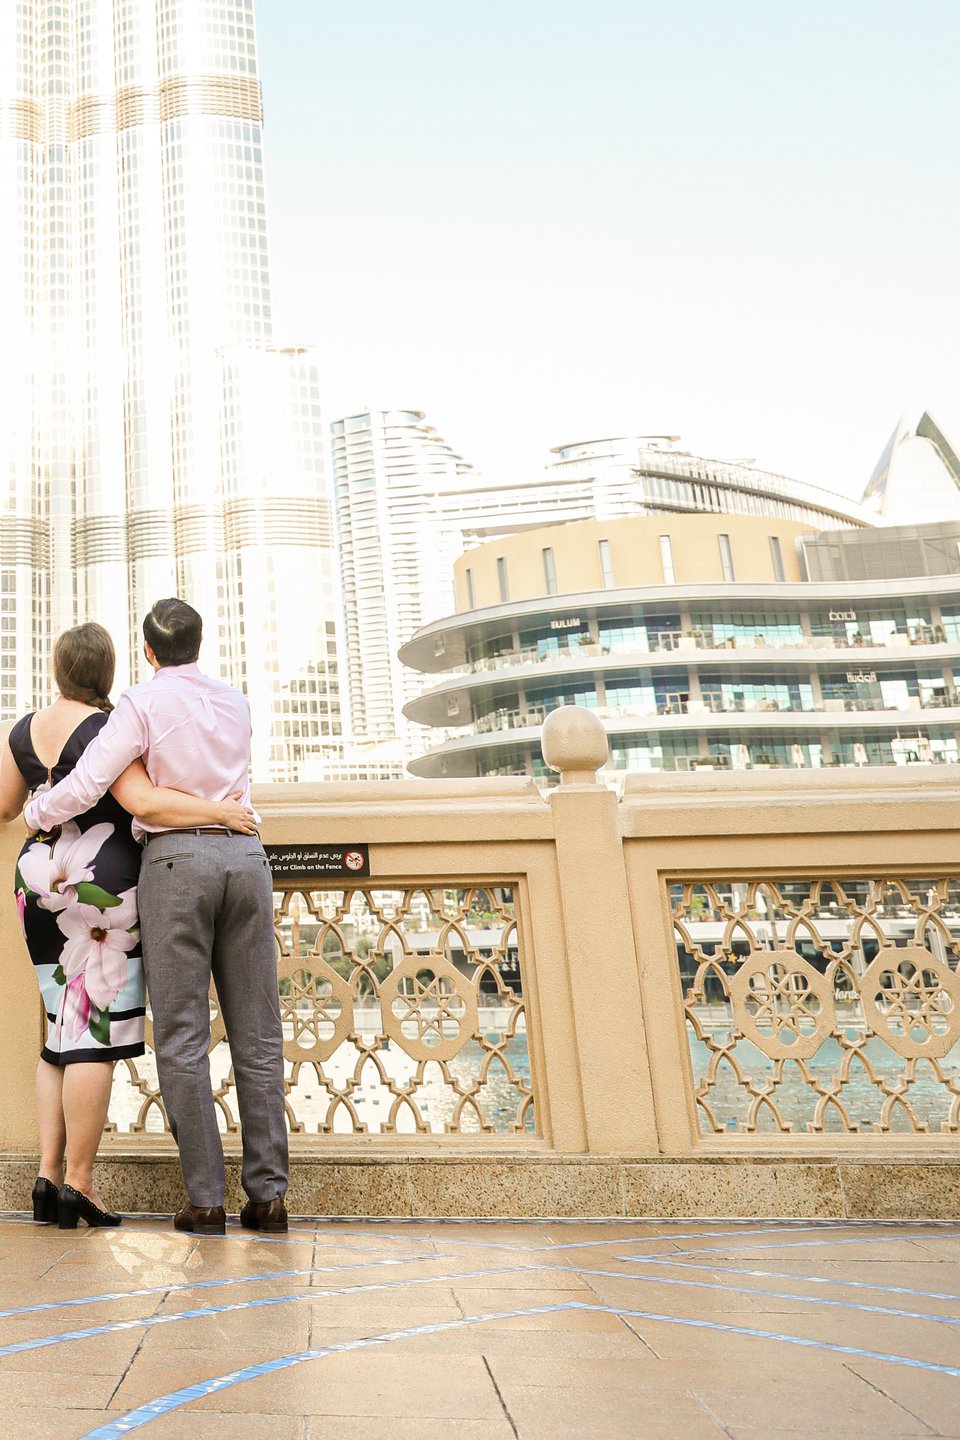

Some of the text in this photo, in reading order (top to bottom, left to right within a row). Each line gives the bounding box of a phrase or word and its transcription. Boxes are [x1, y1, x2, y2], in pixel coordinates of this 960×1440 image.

[550, 618, 581, 629] TULUM
[279, 853, 296, 862] الجلوس
[297, 852, 302, 861] أو
[303, 852, 318, 861] التسلق
[318, 853, 330, 861] عدم
